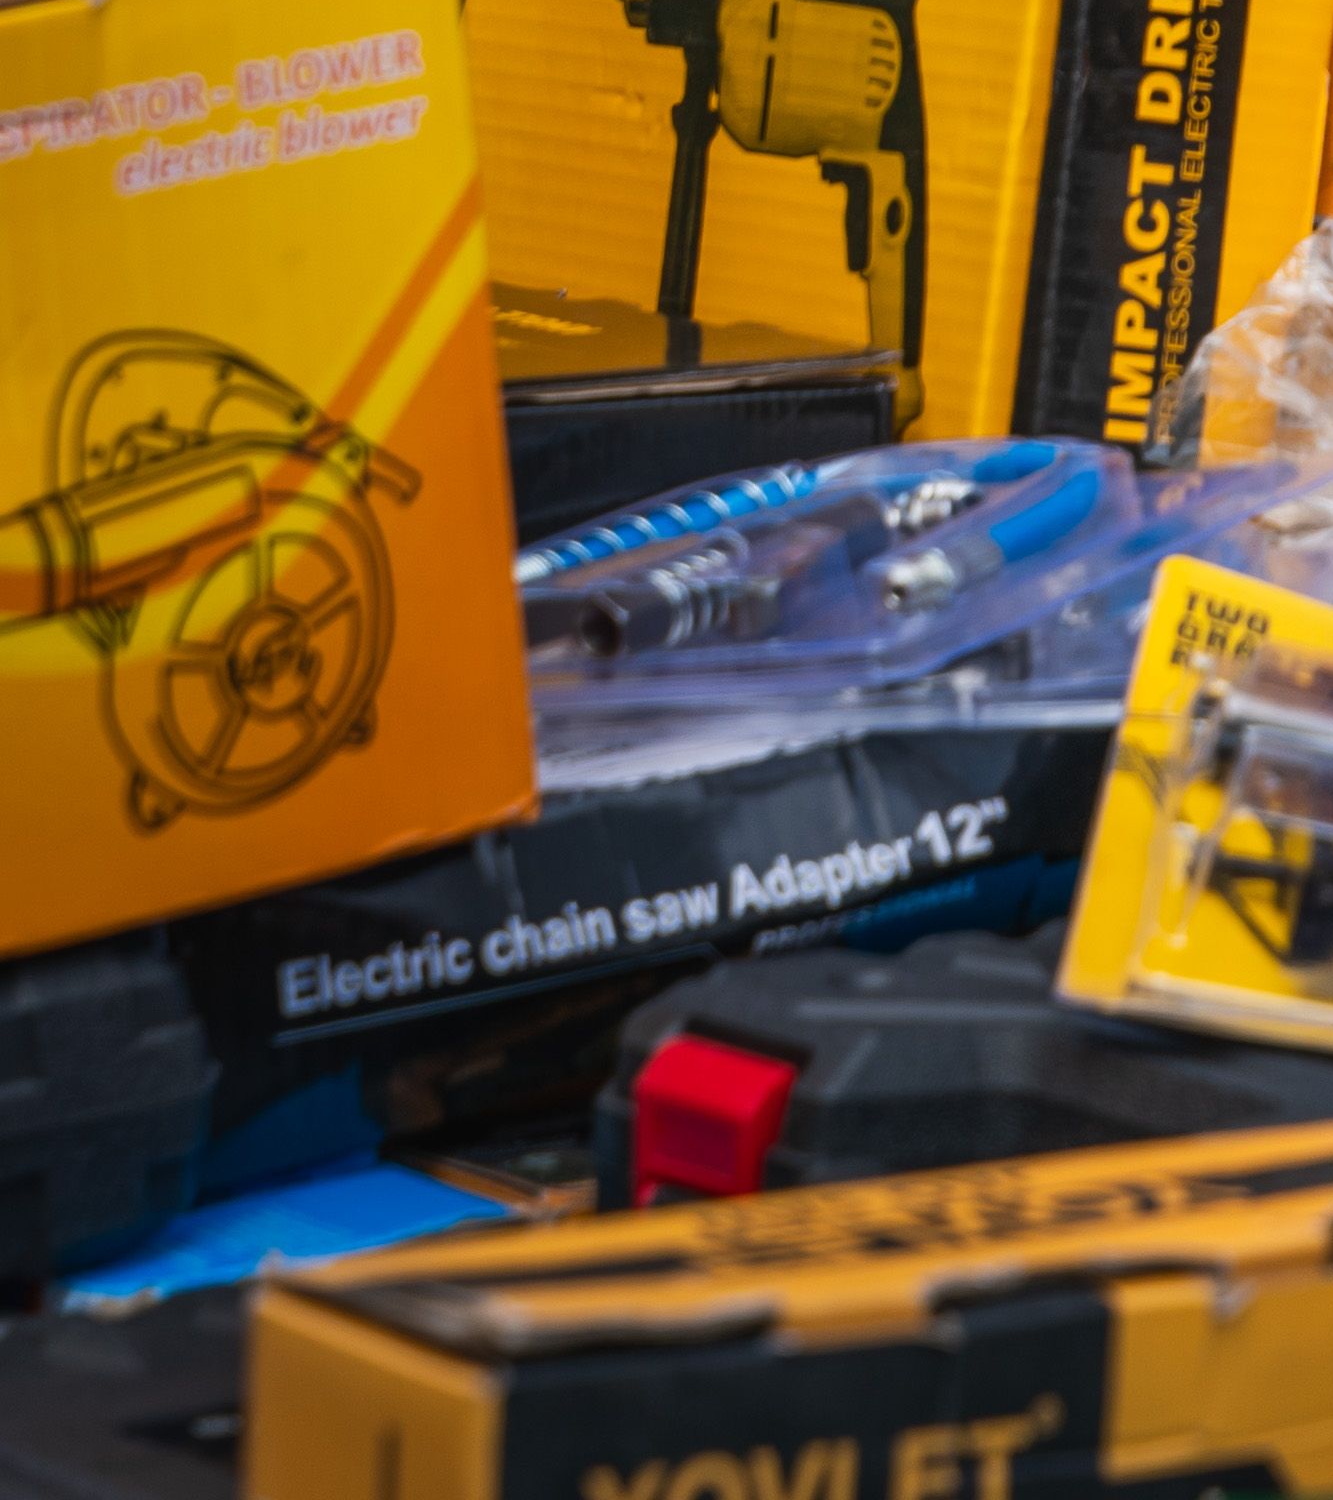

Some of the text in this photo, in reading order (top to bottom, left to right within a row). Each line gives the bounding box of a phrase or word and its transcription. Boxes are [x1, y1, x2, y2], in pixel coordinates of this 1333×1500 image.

[117, 95, 429, 196] electric blower
[237, 29, 425, 109] BLOWER
[1105, 143, 1173, 443] IMPACT
[1155, 190, 1201, 446] PROFESSIONAL
[1181, 12, 1221, 184] ELECTRIC
[277, 937, 474, 1020] Electric
[482, 904, 616, 978] chain
[623, 879, 720, 937] saw
[728, 832, 914, 917] Adapter
[916, 797, 1009, 867] 12"
